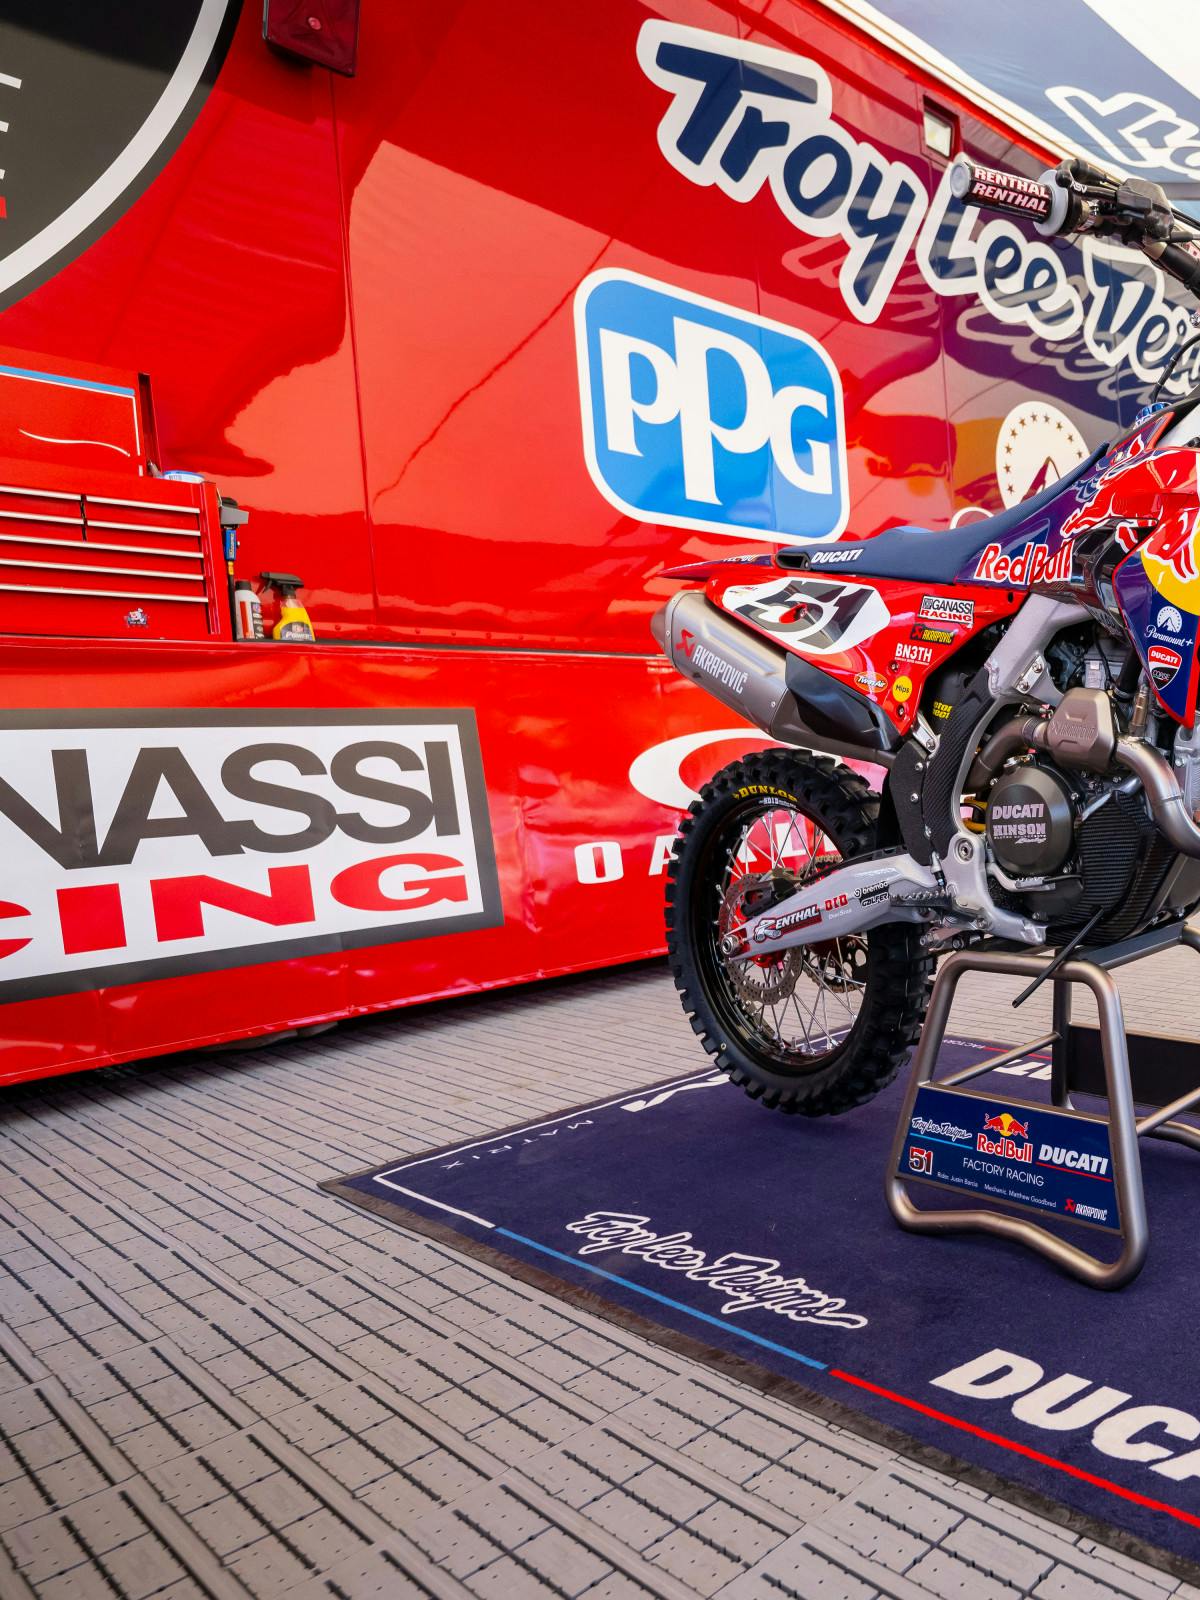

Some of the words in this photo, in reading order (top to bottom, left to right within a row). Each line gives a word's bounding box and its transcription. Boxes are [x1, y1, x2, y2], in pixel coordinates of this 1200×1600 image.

[636, 18, 932, 324] Troy
[922, 150, 1084, 342] Lee
[973, 166, 1050, 200] RENTHAL
[971, 182, 1048, 214] RENTHAL
[599, 316, 835, 506] PPG
[811, 549, 864, 563] DUCATI
[973, 541, 1035, 585] Red
[1027, 537, 1076, 586] Bull
[733, 580, 876, 651] 51
[920, 609, 973, 623] RACING
[933, 599, 973, 615] GANASSI
[895, 642, 933, 663] BN3TH
[1150, 649, 1179, 664] DUCATI
[895, 683, 910, 694] Mips
[992, 803, 1044, 820] DUCATI
[993, 823, 1046, 837] HINSON
[0, 853, 469, 957] ING
[441, 1117, 595, 1171] MATRIX
[911, 1117, 928, 1135] Troy
[939, 1122, 972, 1142] Designs
[908, 1146, 934, 1176] 51
[976, 1133, 1005, 1157] Red
[1004, 1137, 1034, 1164] Bull
[1038, 1144, 1110, 1176] DUCATI
[963, 1157, 1005, 1175] FACTORY
[1006, 1167, 1045, 1187] RACING
[565, 1211, 657, 1255] Troy
[621, 1231, 707, 1270] Lee
[685, 1251, 869, 1329] Designs
